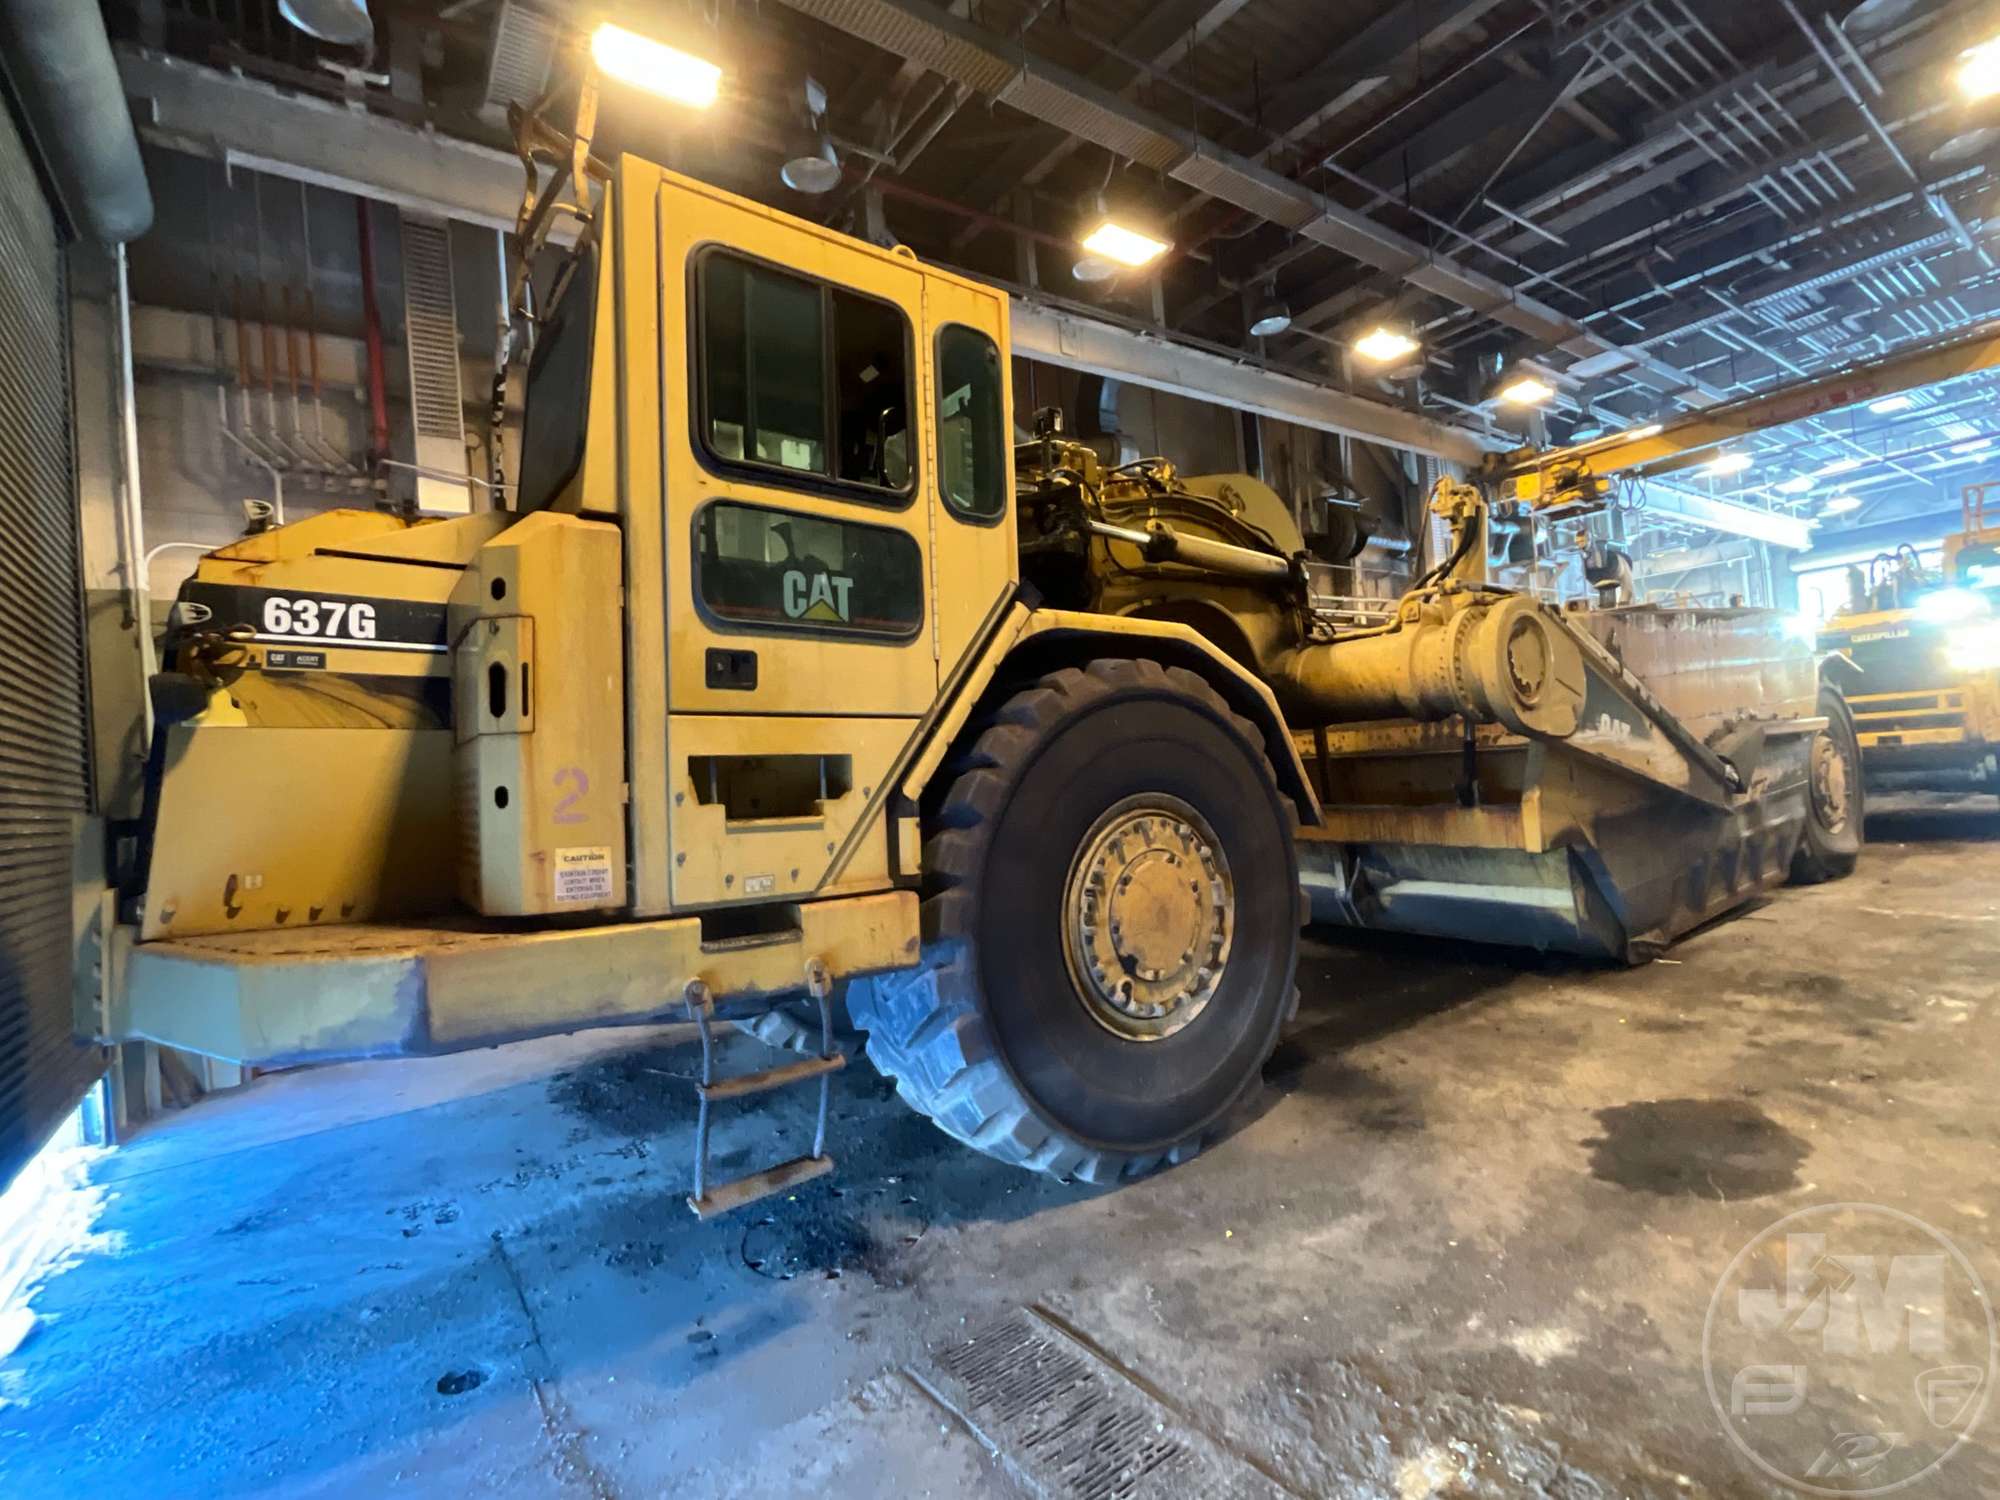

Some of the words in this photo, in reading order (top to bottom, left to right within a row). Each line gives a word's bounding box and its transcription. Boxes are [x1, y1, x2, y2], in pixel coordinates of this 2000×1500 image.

[263, 596, 376, 639] 637G
[782, 568, 854, 622] CAT
[553, 766, 590, 825] 2
[563, 854, 605, 862] CAUTION
